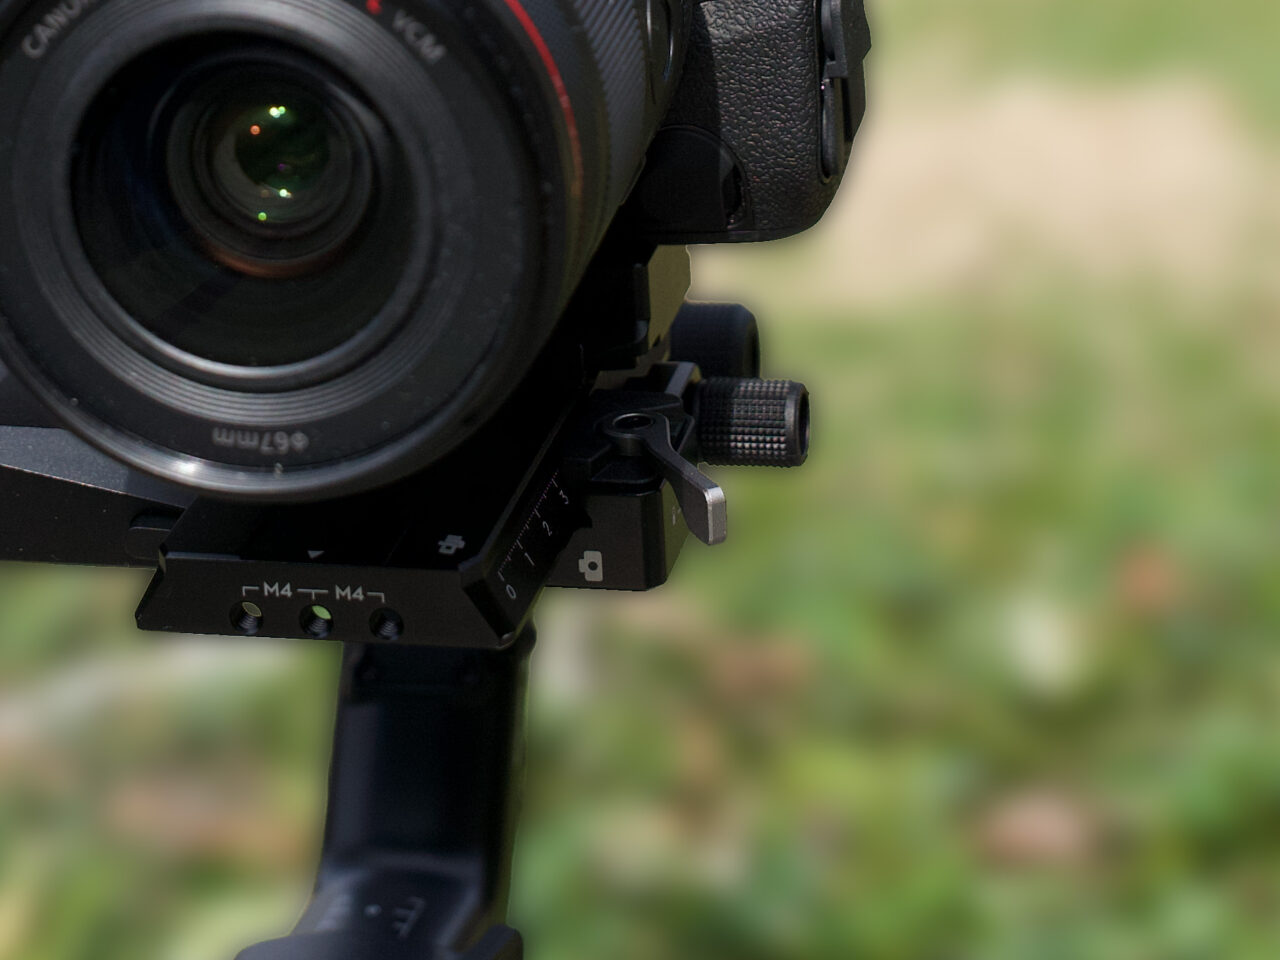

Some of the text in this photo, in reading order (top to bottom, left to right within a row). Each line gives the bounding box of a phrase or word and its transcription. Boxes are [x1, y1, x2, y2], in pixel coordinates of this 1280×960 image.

[392, 9, 447, 65] VCM
[559, 489, 569, 505] 3
[542, 520, 553, 537] 2
[262, 580, 365, 602] M4 M4
